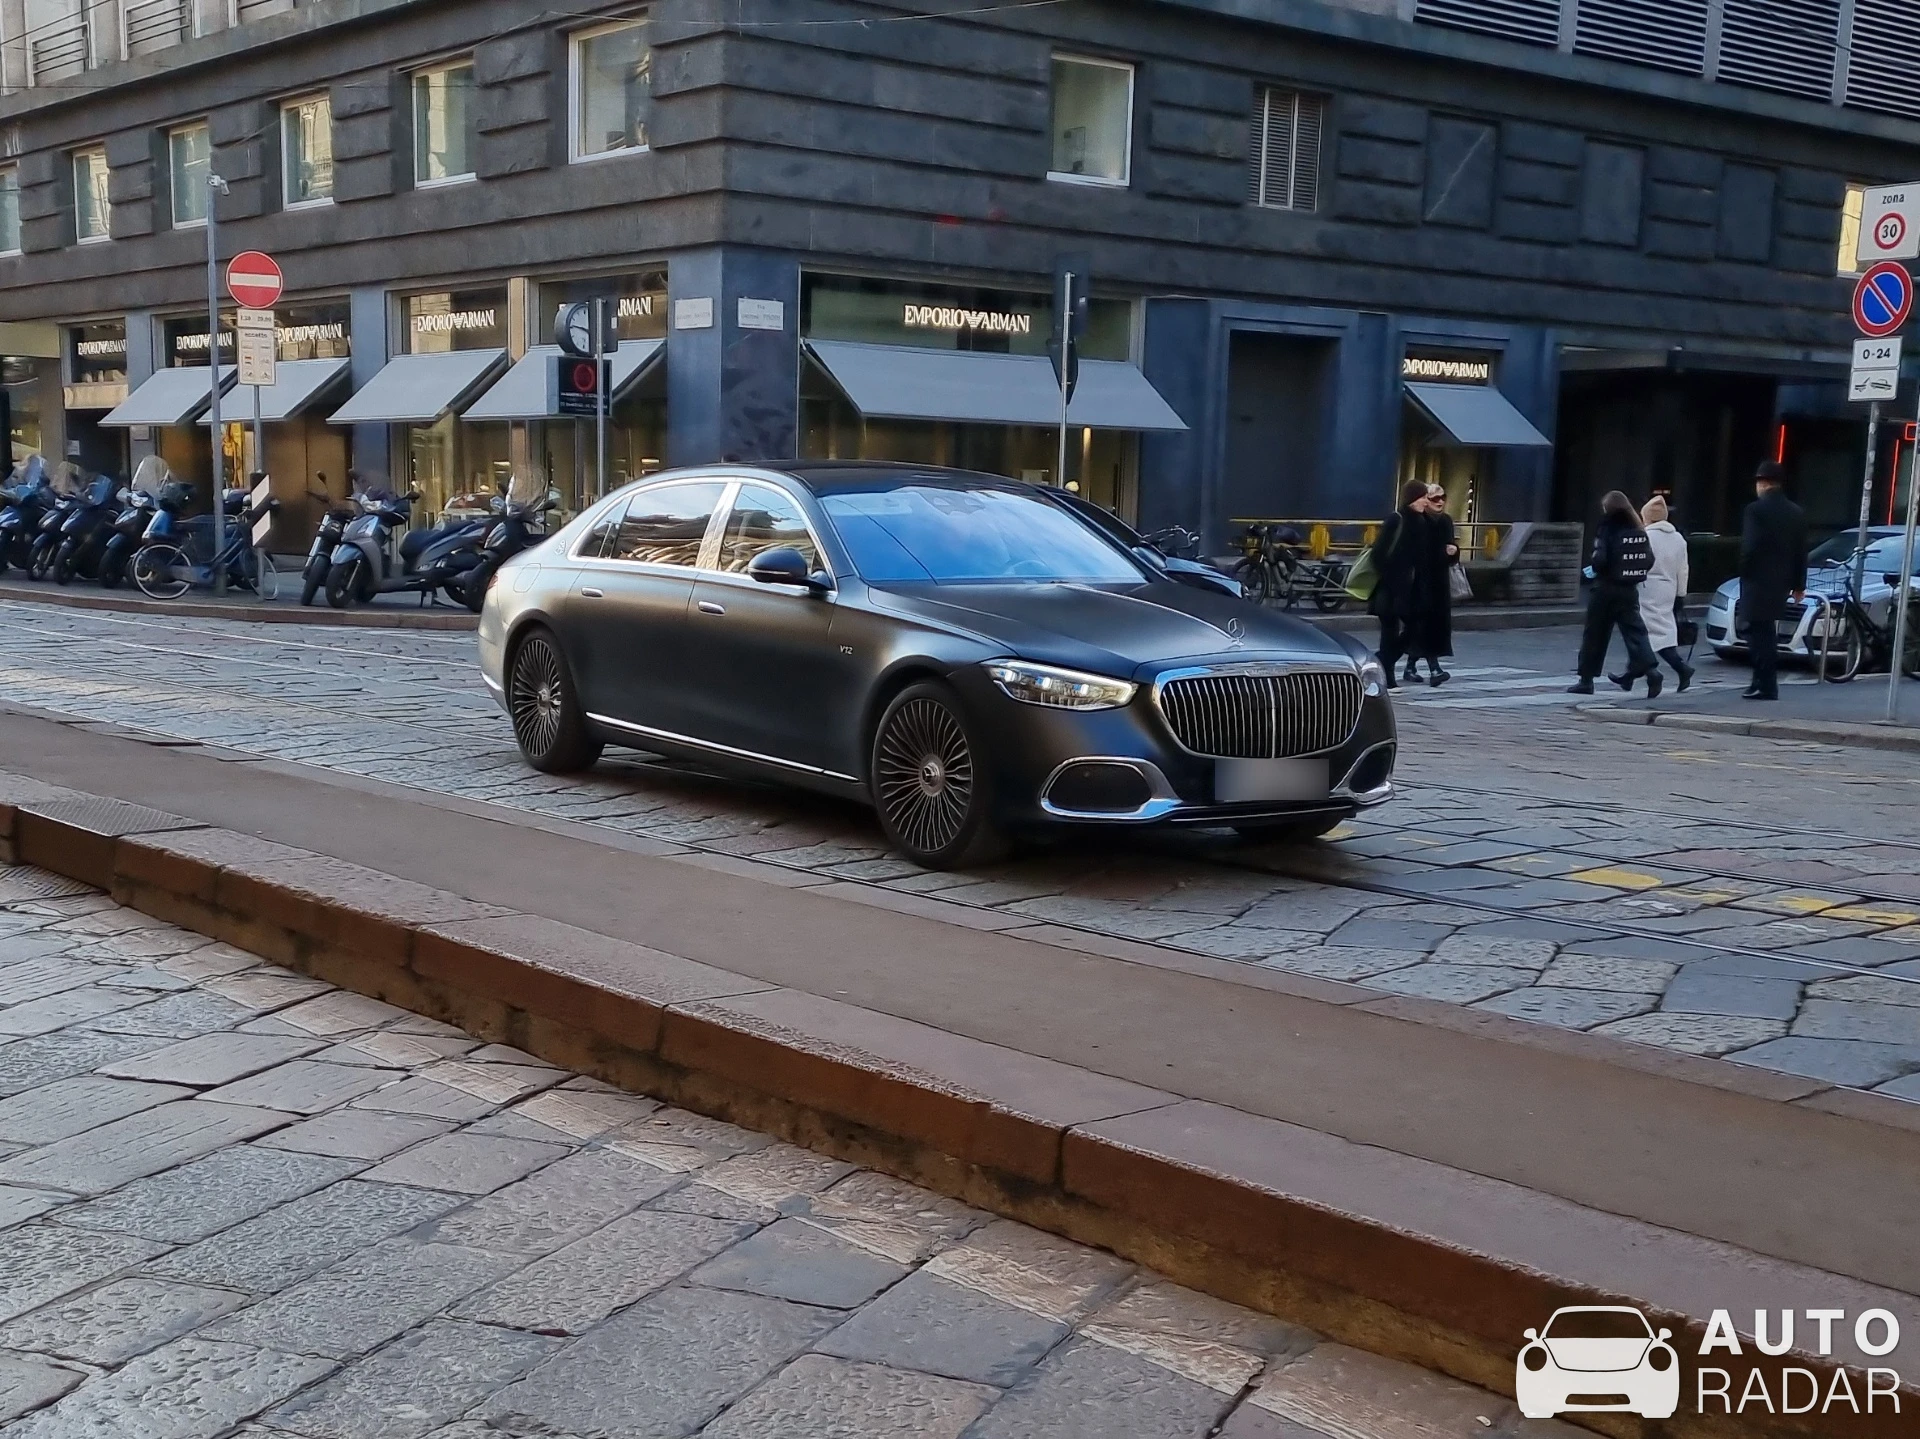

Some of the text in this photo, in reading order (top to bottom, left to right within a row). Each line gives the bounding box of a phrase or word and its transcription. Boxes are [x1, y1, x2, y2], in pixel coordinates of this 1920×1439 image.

[1882, 193, 1905, 205] zona
[1881, 223, 1897, 239] 30
[417, 309, 495, 332] EMPORIO ARMANI
[904, 304, 1030, 333] EMPORIO ARMANI
[277, 323, 343, 344] EMPORIO ARMANI
[1862, 348, 1891, 360] 0-24
[1452, 362, 1488, 379] ARMANI
